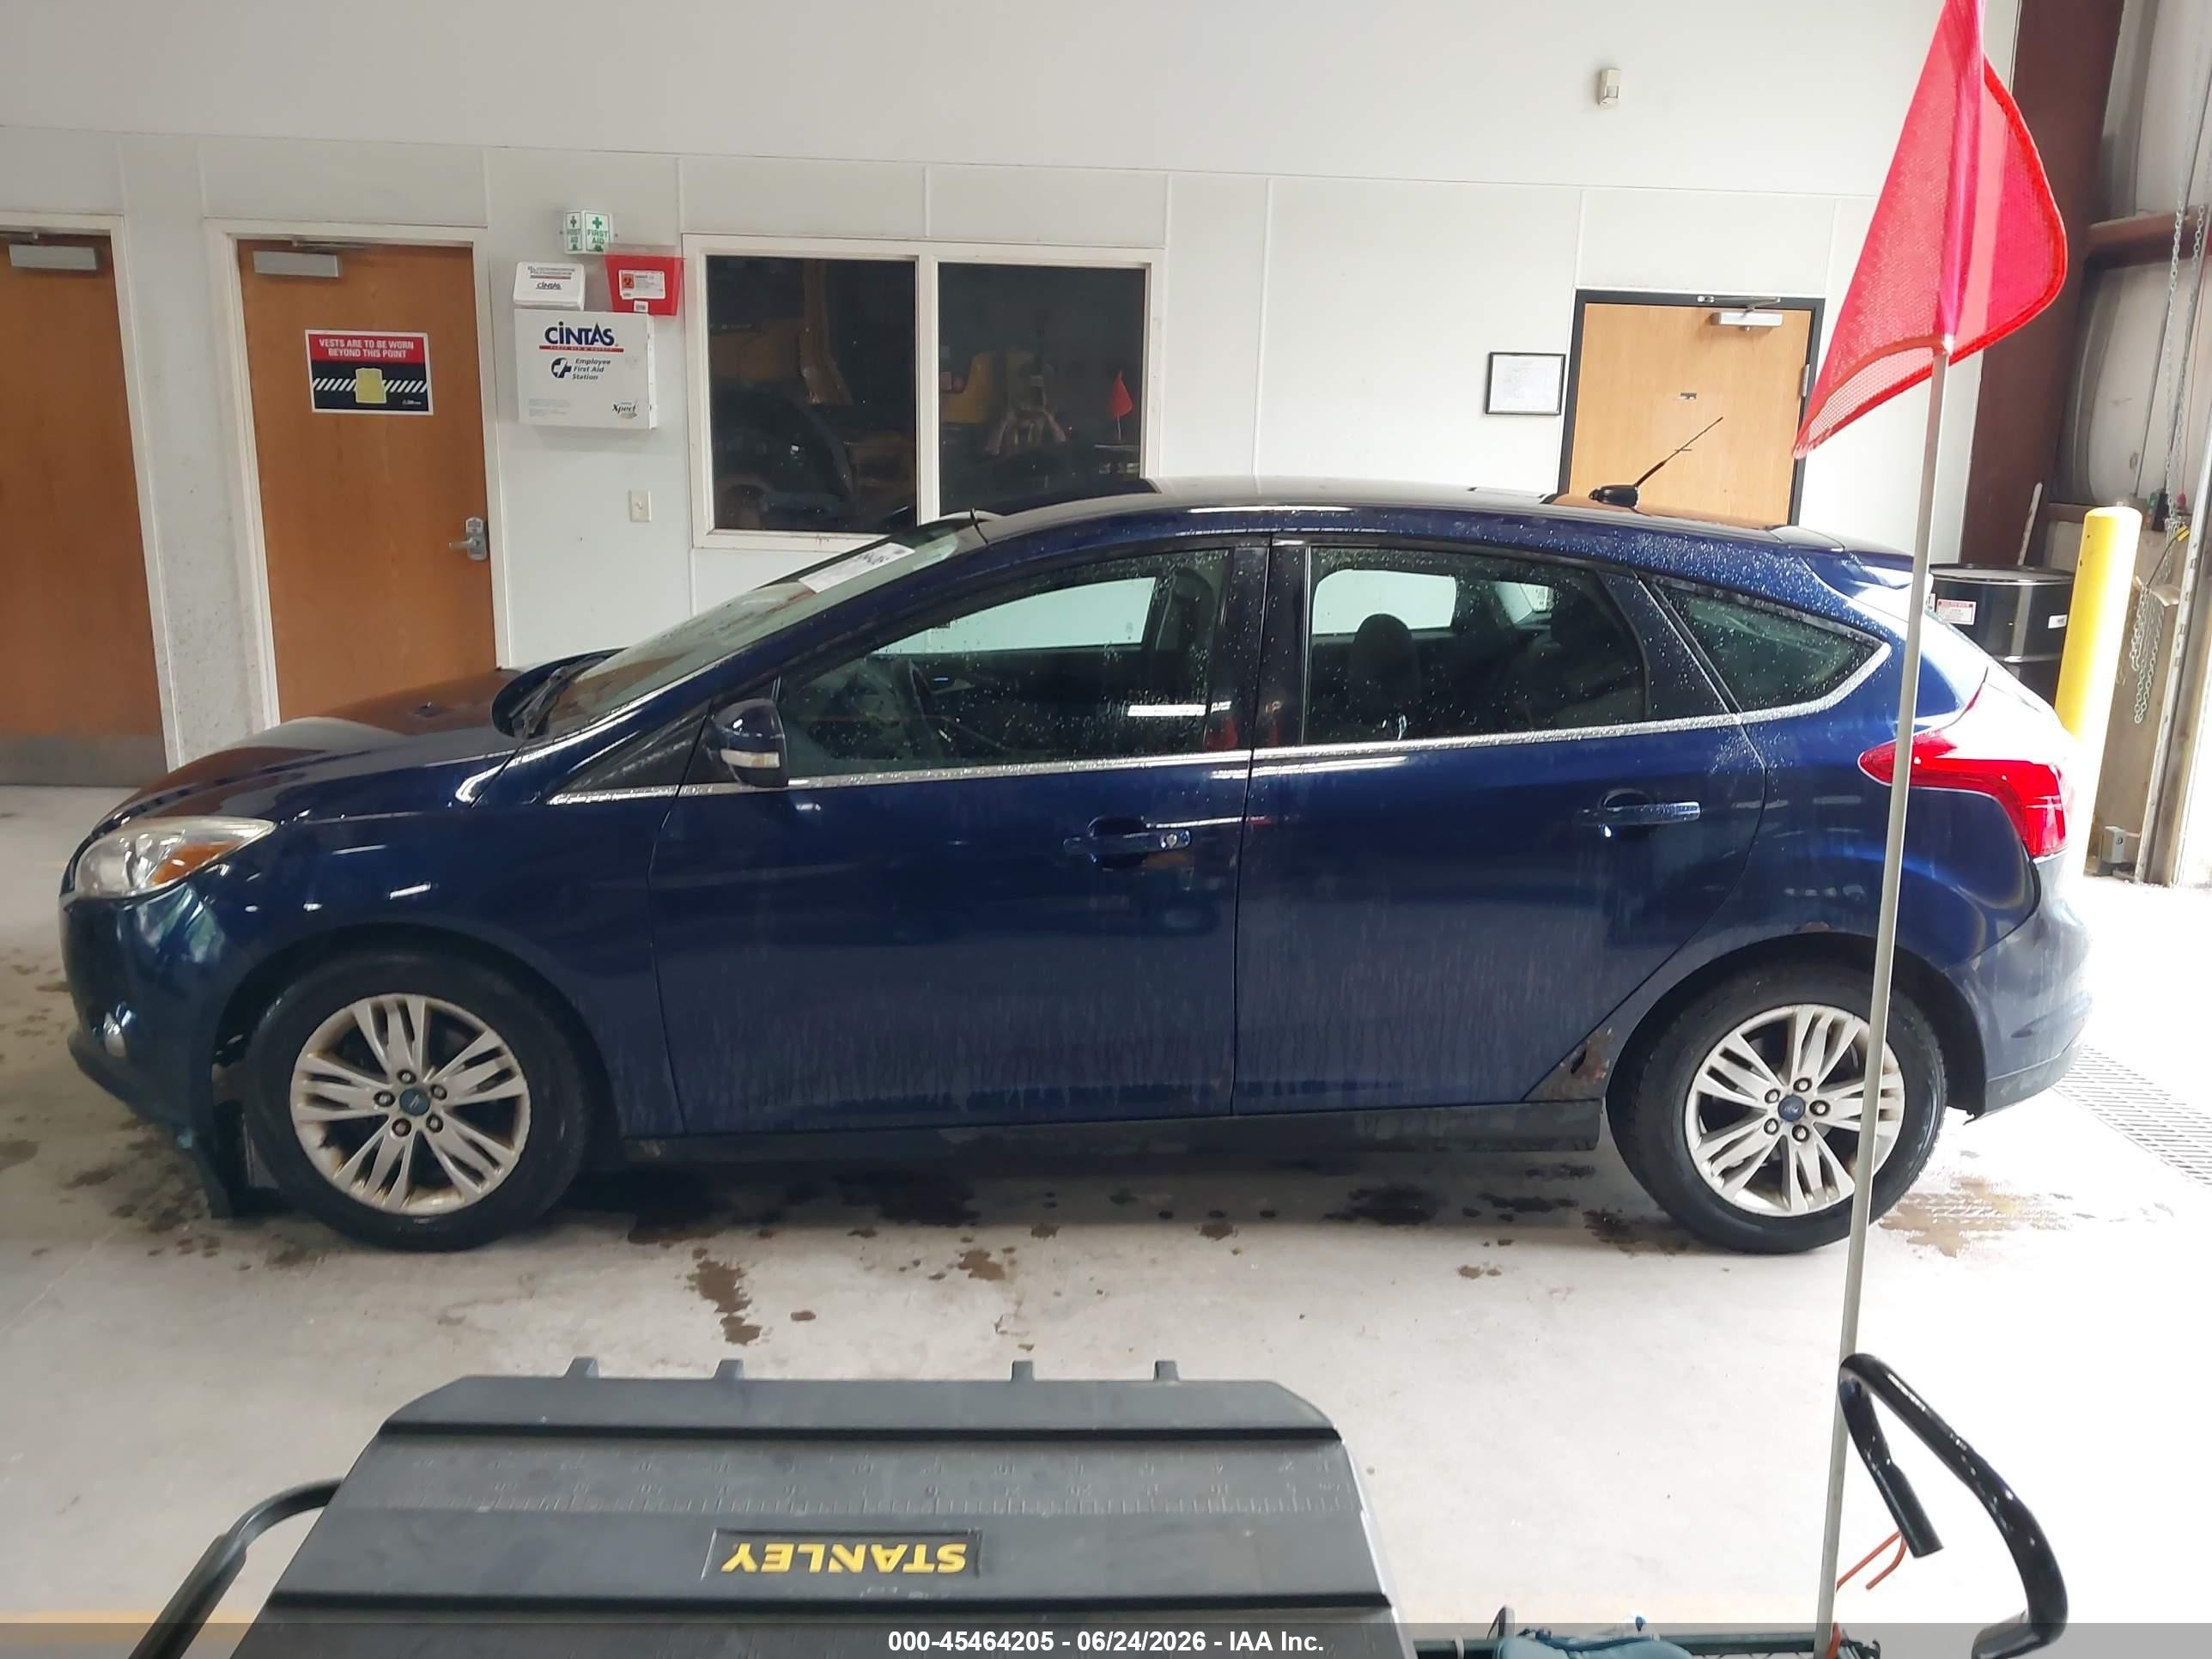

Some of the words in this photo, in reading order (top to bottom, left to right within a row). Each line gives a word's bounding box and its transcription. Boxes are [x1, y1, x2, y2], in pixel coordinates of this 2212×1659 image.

[587, 228, 608, 238] FIRST
[319, 338, 345, 347] VESTS
[346, 339, 362, 348] ARE
[364, 340, 374, 349] TO
[388, 341, 414, 349] WORN
[328, 348, 361, 357] BEYOND
[362, 349, 380, 357] THIS
[382, 349, 407, 358] POINT
[575, 358, 611, 367] Employee
[720, 1542, 968, 1574] STANLEY
